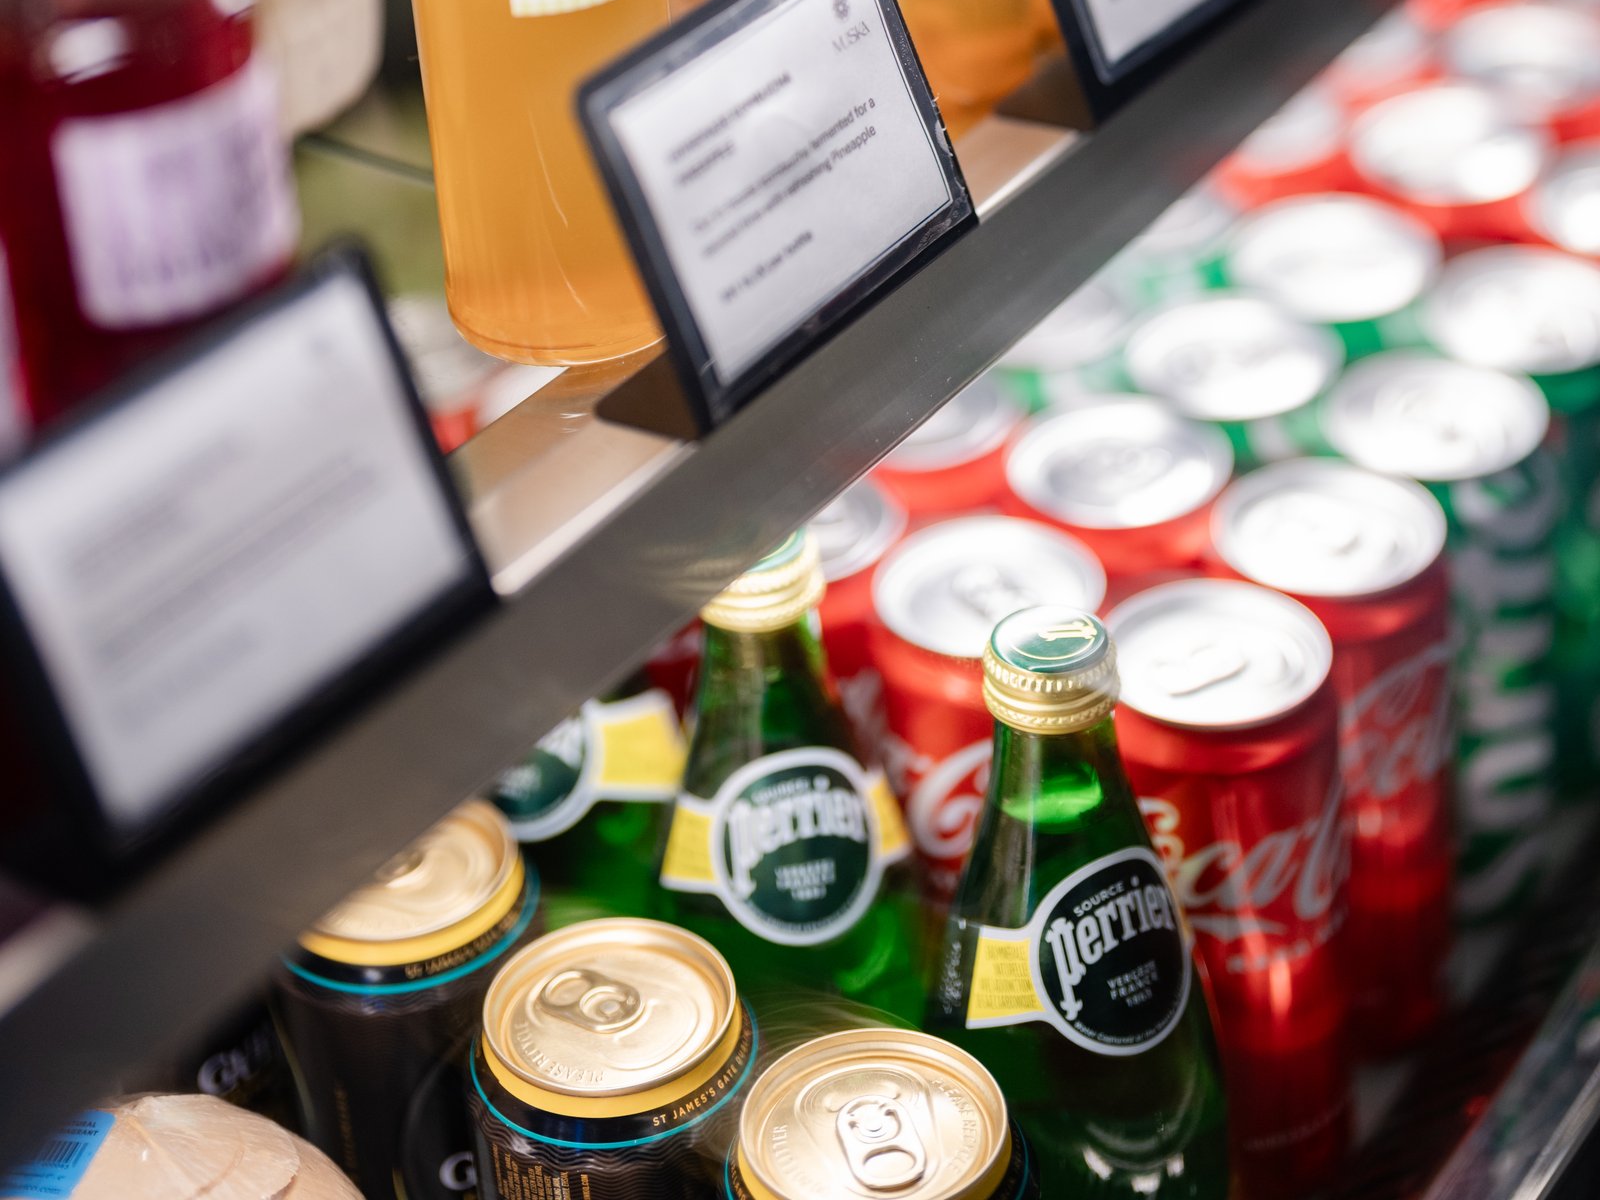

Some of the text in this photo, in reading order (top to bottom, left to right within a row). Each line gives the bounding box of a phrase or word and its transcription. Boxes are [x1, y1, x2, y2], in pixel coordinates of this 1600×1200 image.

[854, 102, 869, 119] for
[868, 97, 877, 109] a
[830, 124, 877, 163] Pineapple
[1072, 880, 1126, 918] SOURCE
[652, 1113, 667, 1127] ST
[672, 1087, 716, 1120] JAMES'S
[717, 1064, 738, 1089] GATE
